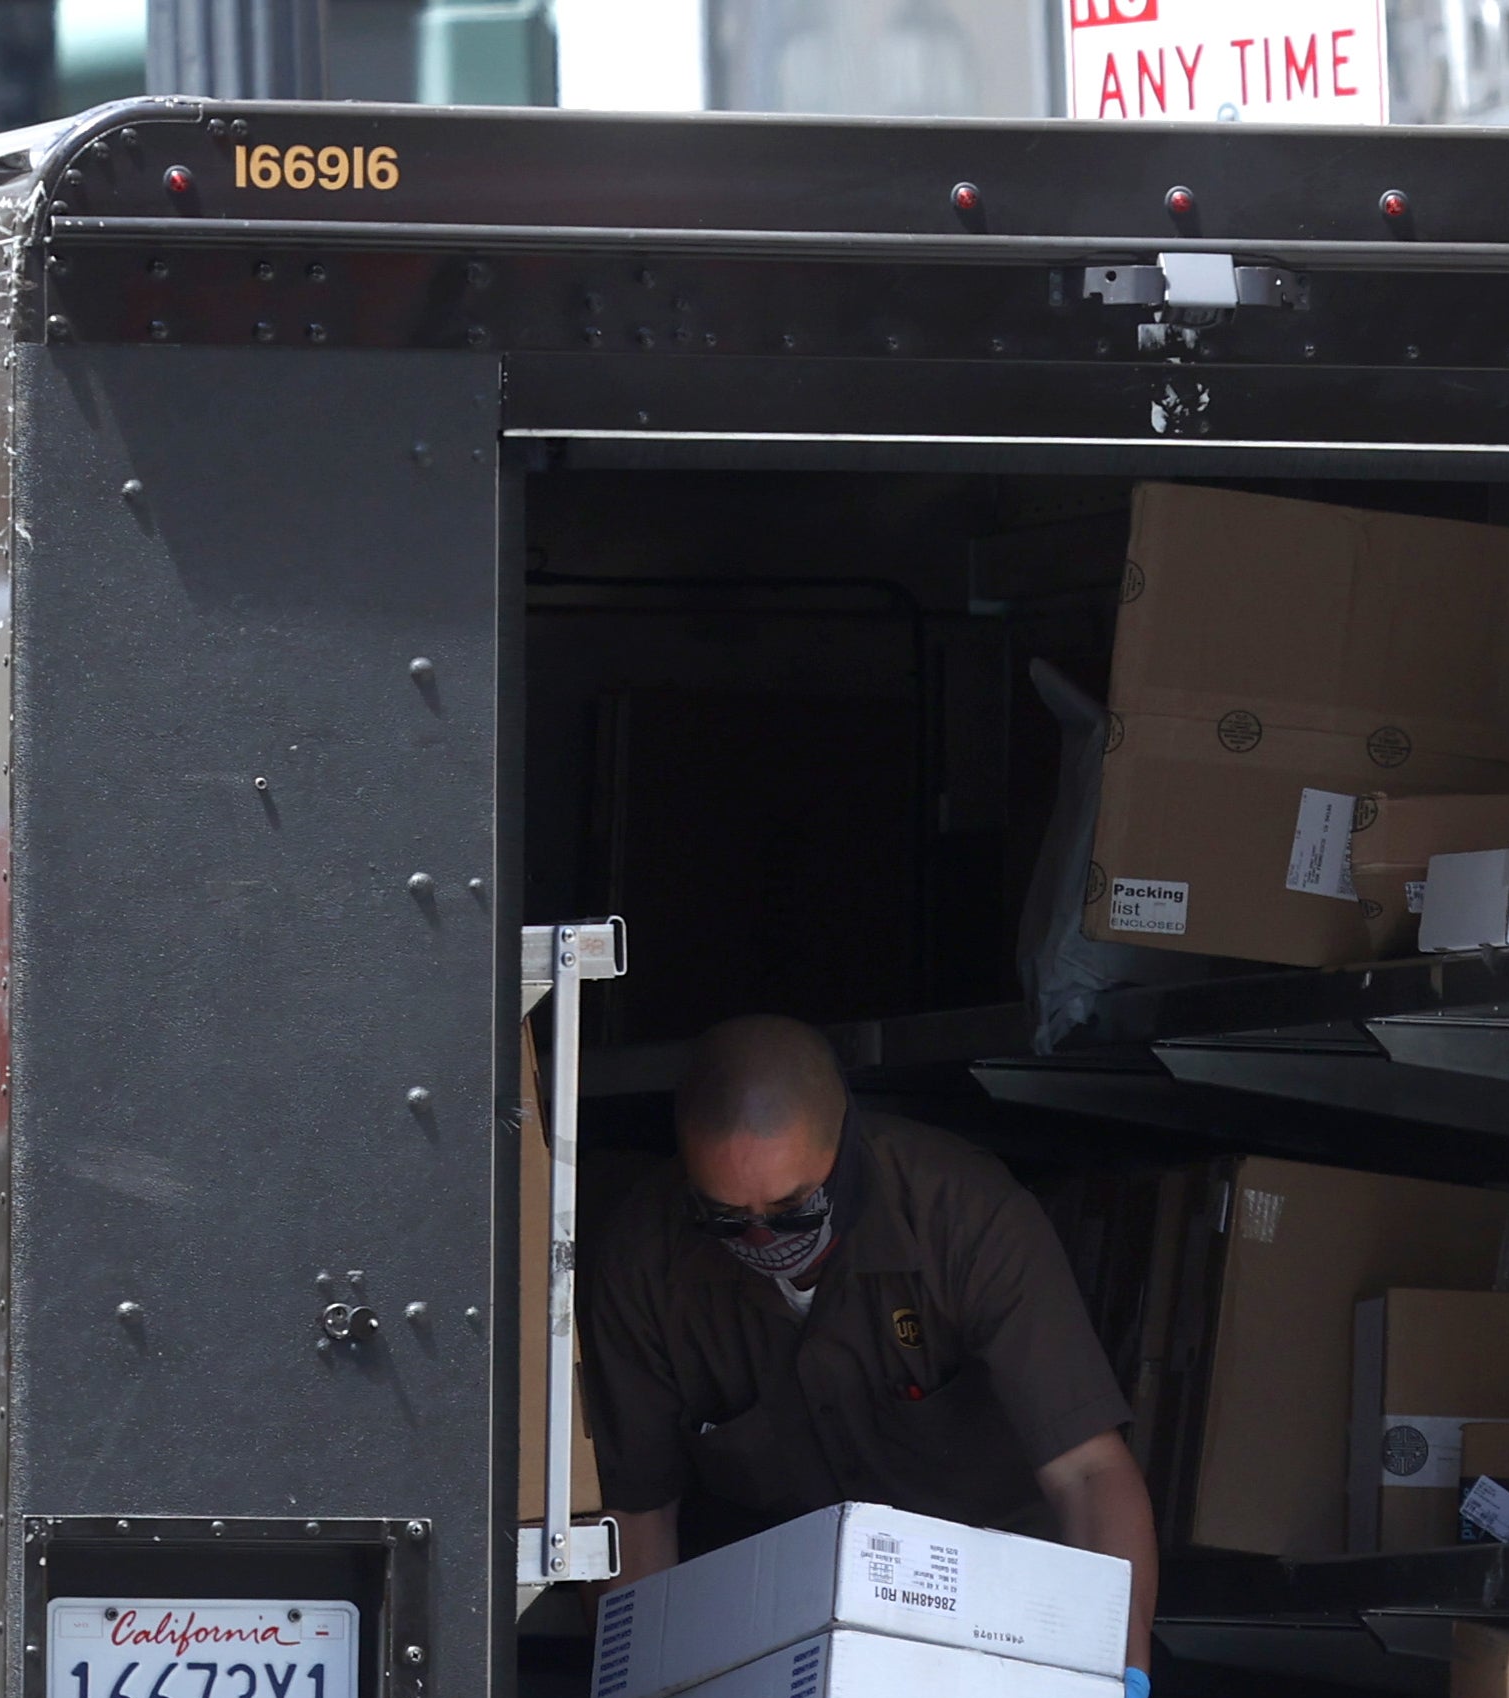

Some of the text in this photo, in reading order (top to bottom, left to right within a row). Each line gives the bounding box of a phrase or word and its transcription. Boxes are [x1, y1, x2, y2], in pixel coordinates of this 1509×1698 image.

[1099, 29, 1358, 118] ANY TIME
[235, 144, 399, 190] 166916
[1114, 884, 1184, 903] Packing
[1112, 900, 1140, 916] list
[1111, 918, 1185, 931] ENCLOSED
[875, 1586, 956, 1611] Z8648HN R01
[111, 1610, 301, 1656] California
